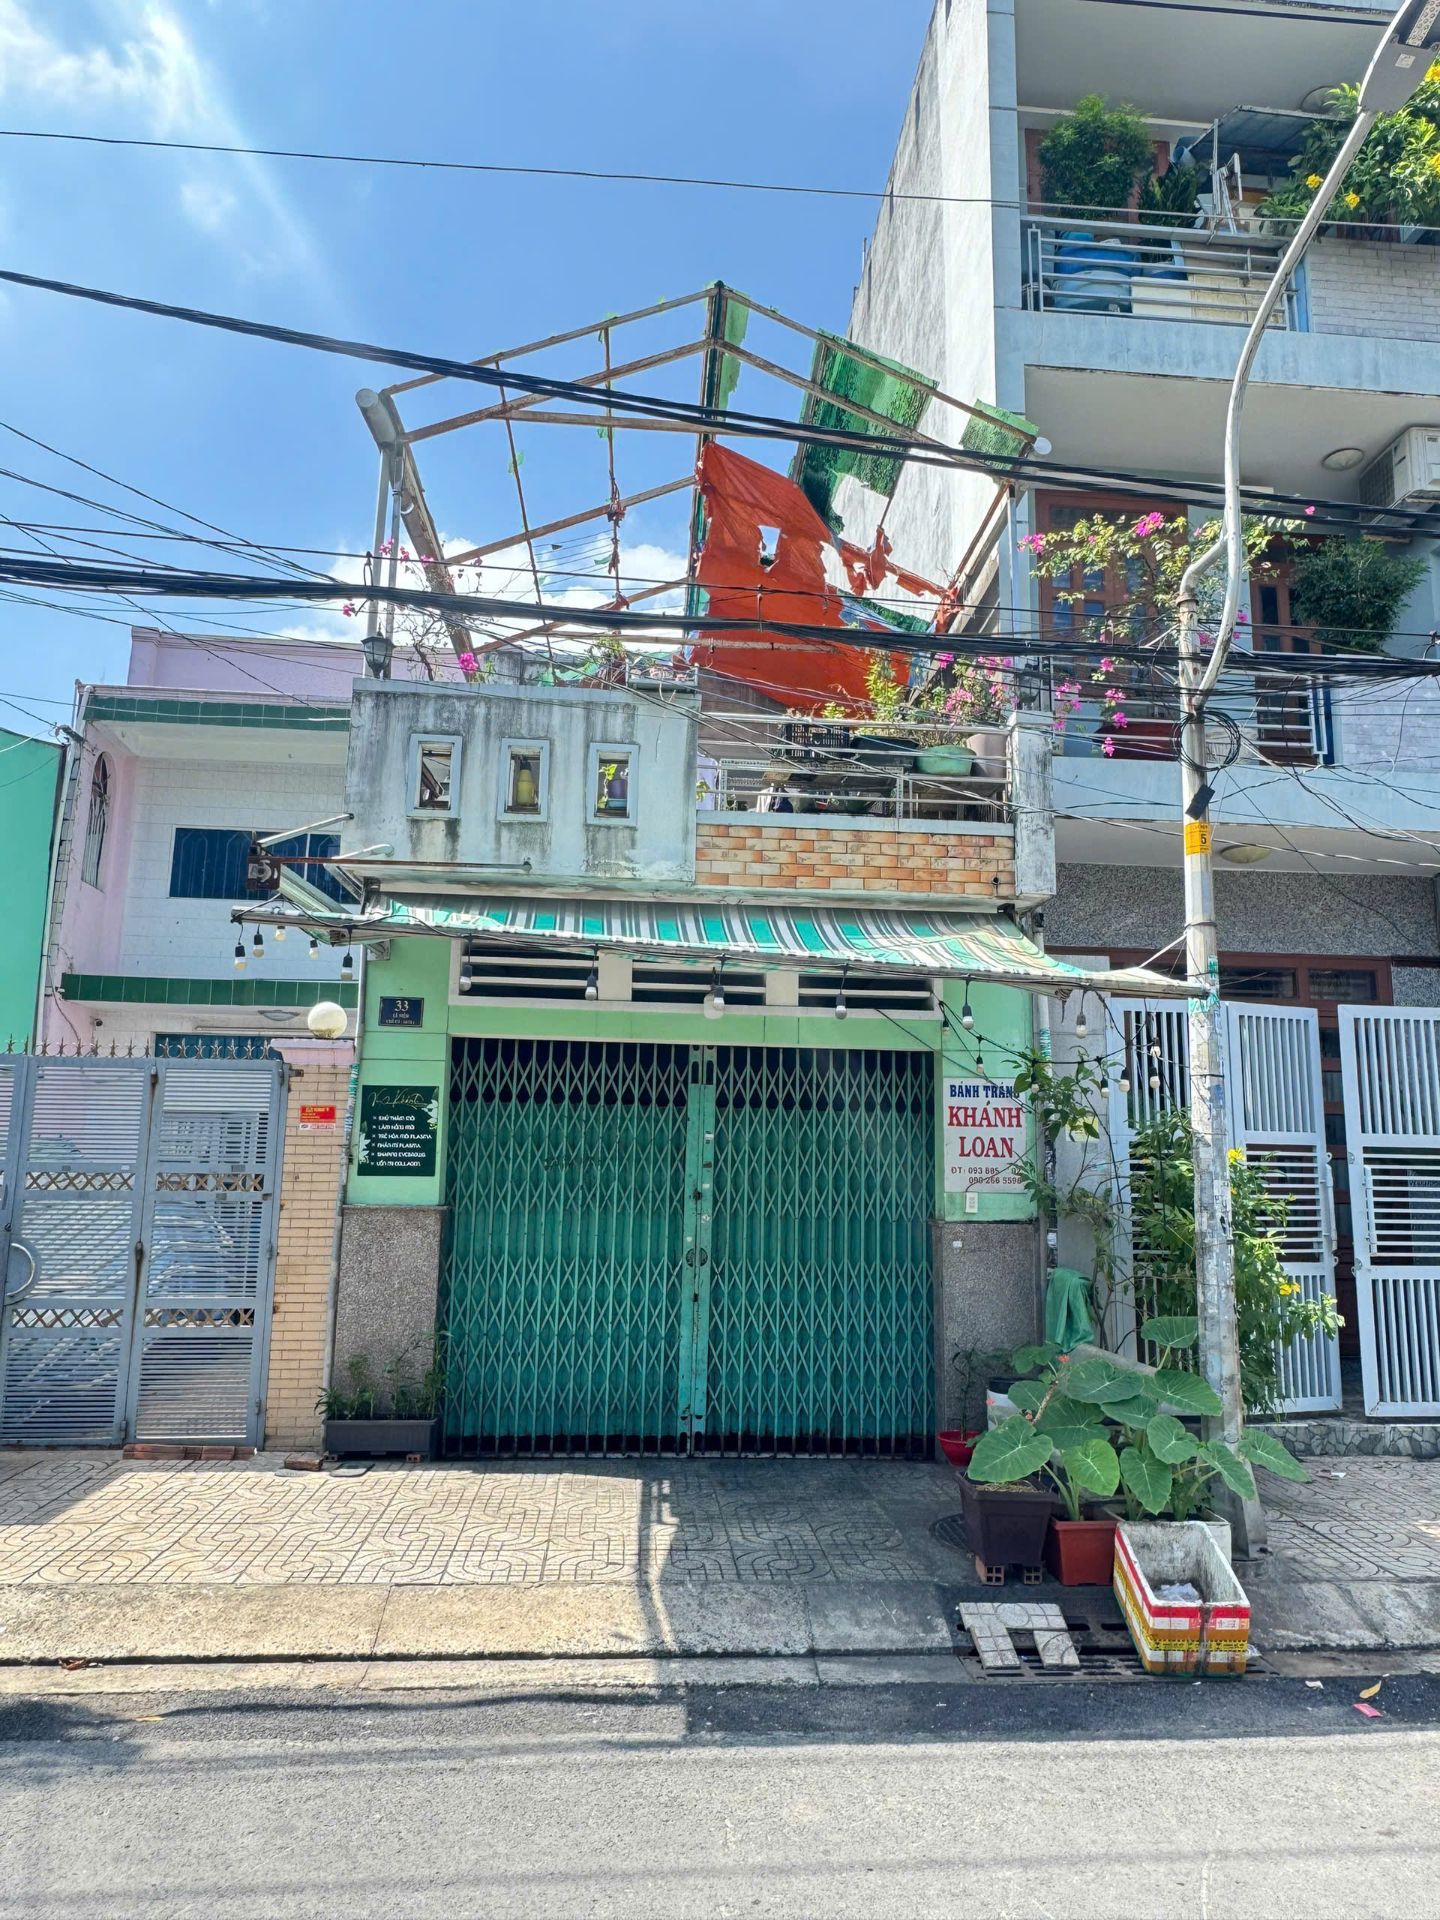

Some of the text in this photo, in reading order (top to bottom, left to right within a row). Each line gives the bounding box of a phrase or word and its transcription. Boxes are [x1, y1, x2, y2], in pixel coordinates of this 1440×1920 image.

[394, 1000, 409, 1012] 33
[949, 1081, 979, 1098] BÁNH
[947, 1100, 1023, 1128] KHÁNH
[958, 1136, 1014, 1158] LOAN
